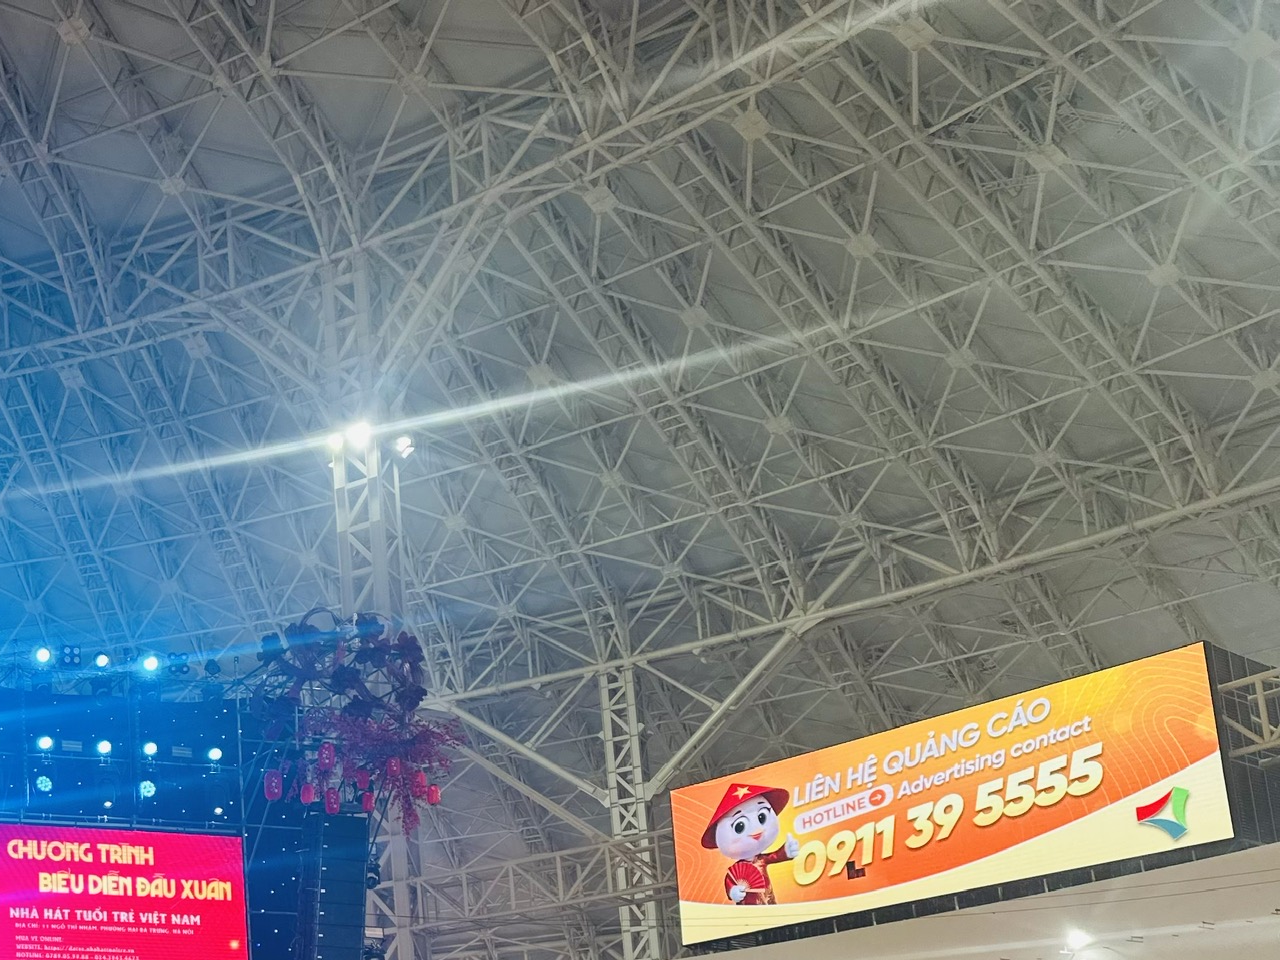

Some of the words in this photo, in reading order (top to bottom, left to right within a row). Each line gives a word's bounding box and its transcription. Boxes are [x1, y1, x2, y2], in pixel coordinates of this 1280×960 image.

[792, 770, 840, 808] LIÊN
[846, 752, 878, 795] HỆ
[882, 722, 980, 775] QUẢNG
[986, 697, 1051, 739] CÁO
[801, 797, 868, 829] HOTLINE
[896, 747, 1006, 800] Advertising
[1009, 715, 1092, 760] contact
[792, 815, 896, 886] 0911
[904, 796, 965, 850] 39
[974, 741, 1106, 827] 5555
[9, 905, 39, 920] NHÀ
[44, 906, 70, 921] HÁT
[140, 910, 168, 926] VIỆT
[172, 914, 201, 926] NAM
